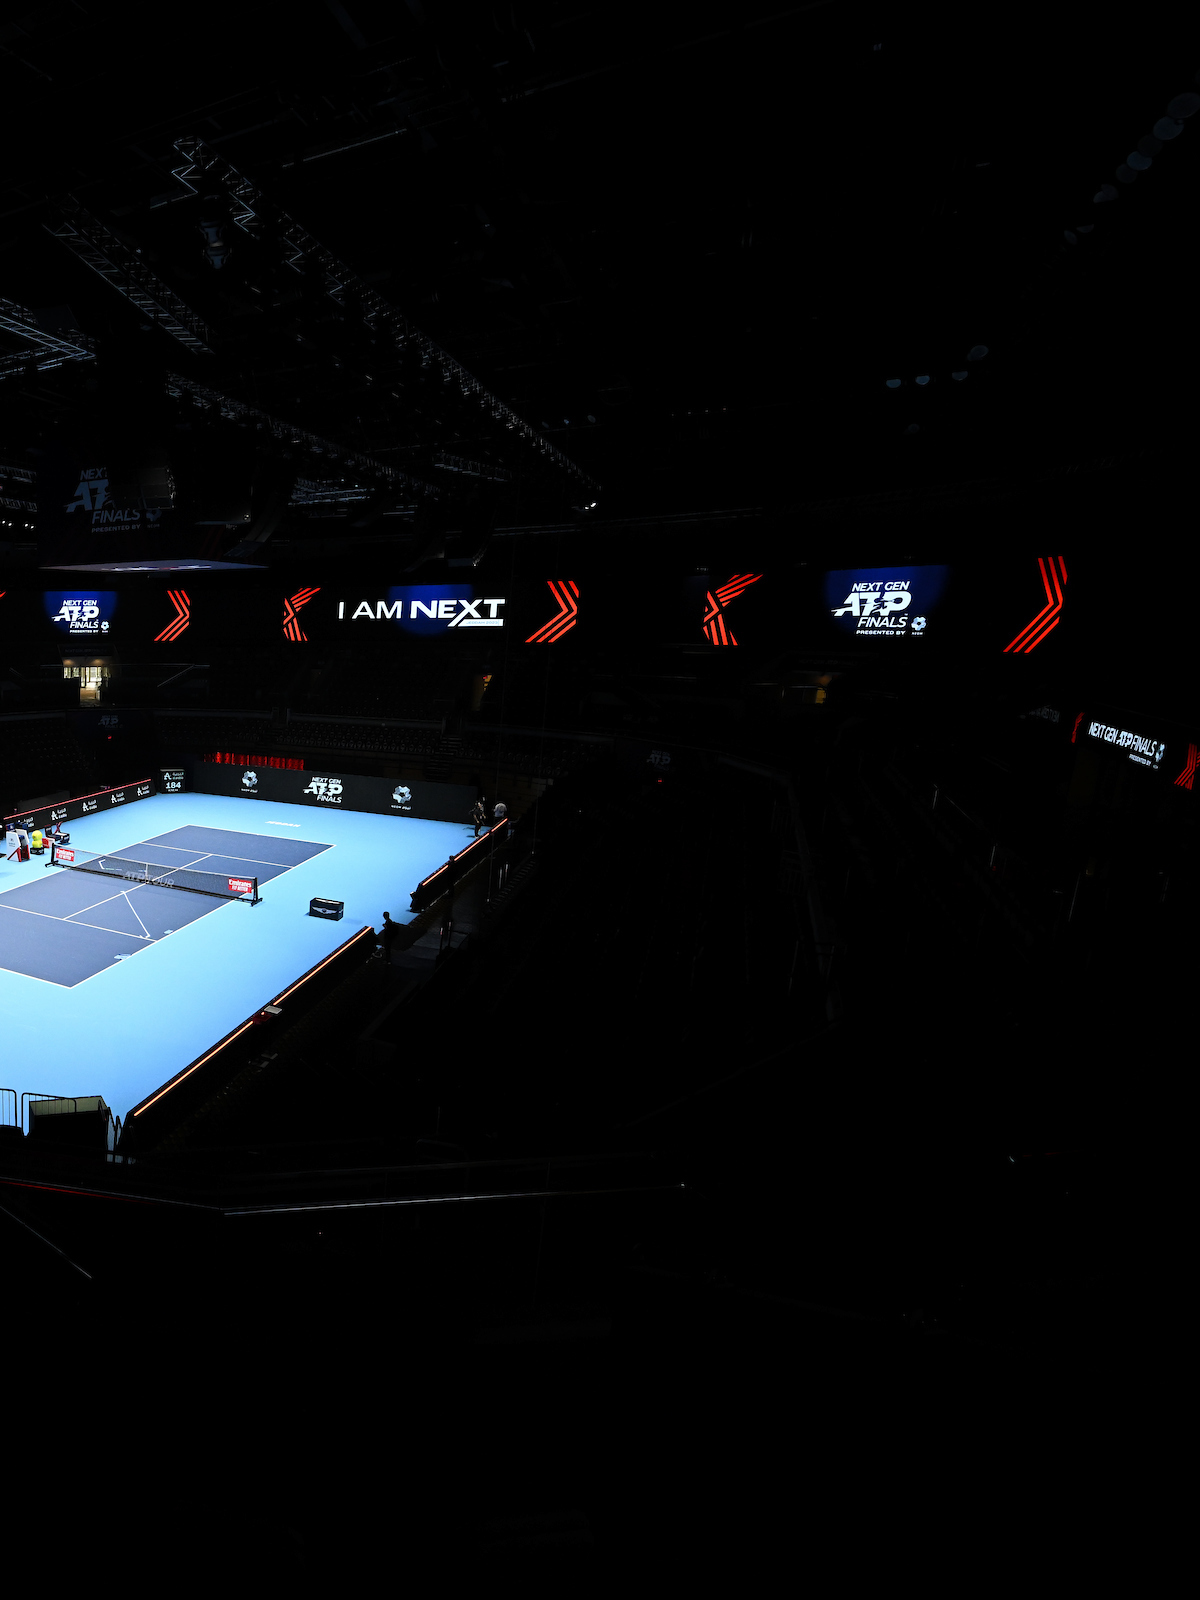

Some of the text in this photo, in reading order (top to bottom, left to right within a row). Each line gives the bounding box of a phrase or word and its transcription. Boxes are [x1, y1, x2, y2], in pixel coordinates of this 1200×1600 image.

[92, 509, 141, 524] FINALS
[852, 581, 910, 592] NEXT GEN
[831, 591, 912, 616] ATP
[52, 606, 99, 621] ATP
[338, 599, 505, 627] I AM NEXT
[858, 617, 908, 628] FINALS
[1088, 722, 1157, 756] NEXT GEN ATP FINALS
[303, 782, 343, 796] ATP
[317, 795, 342, 803] FINALS
